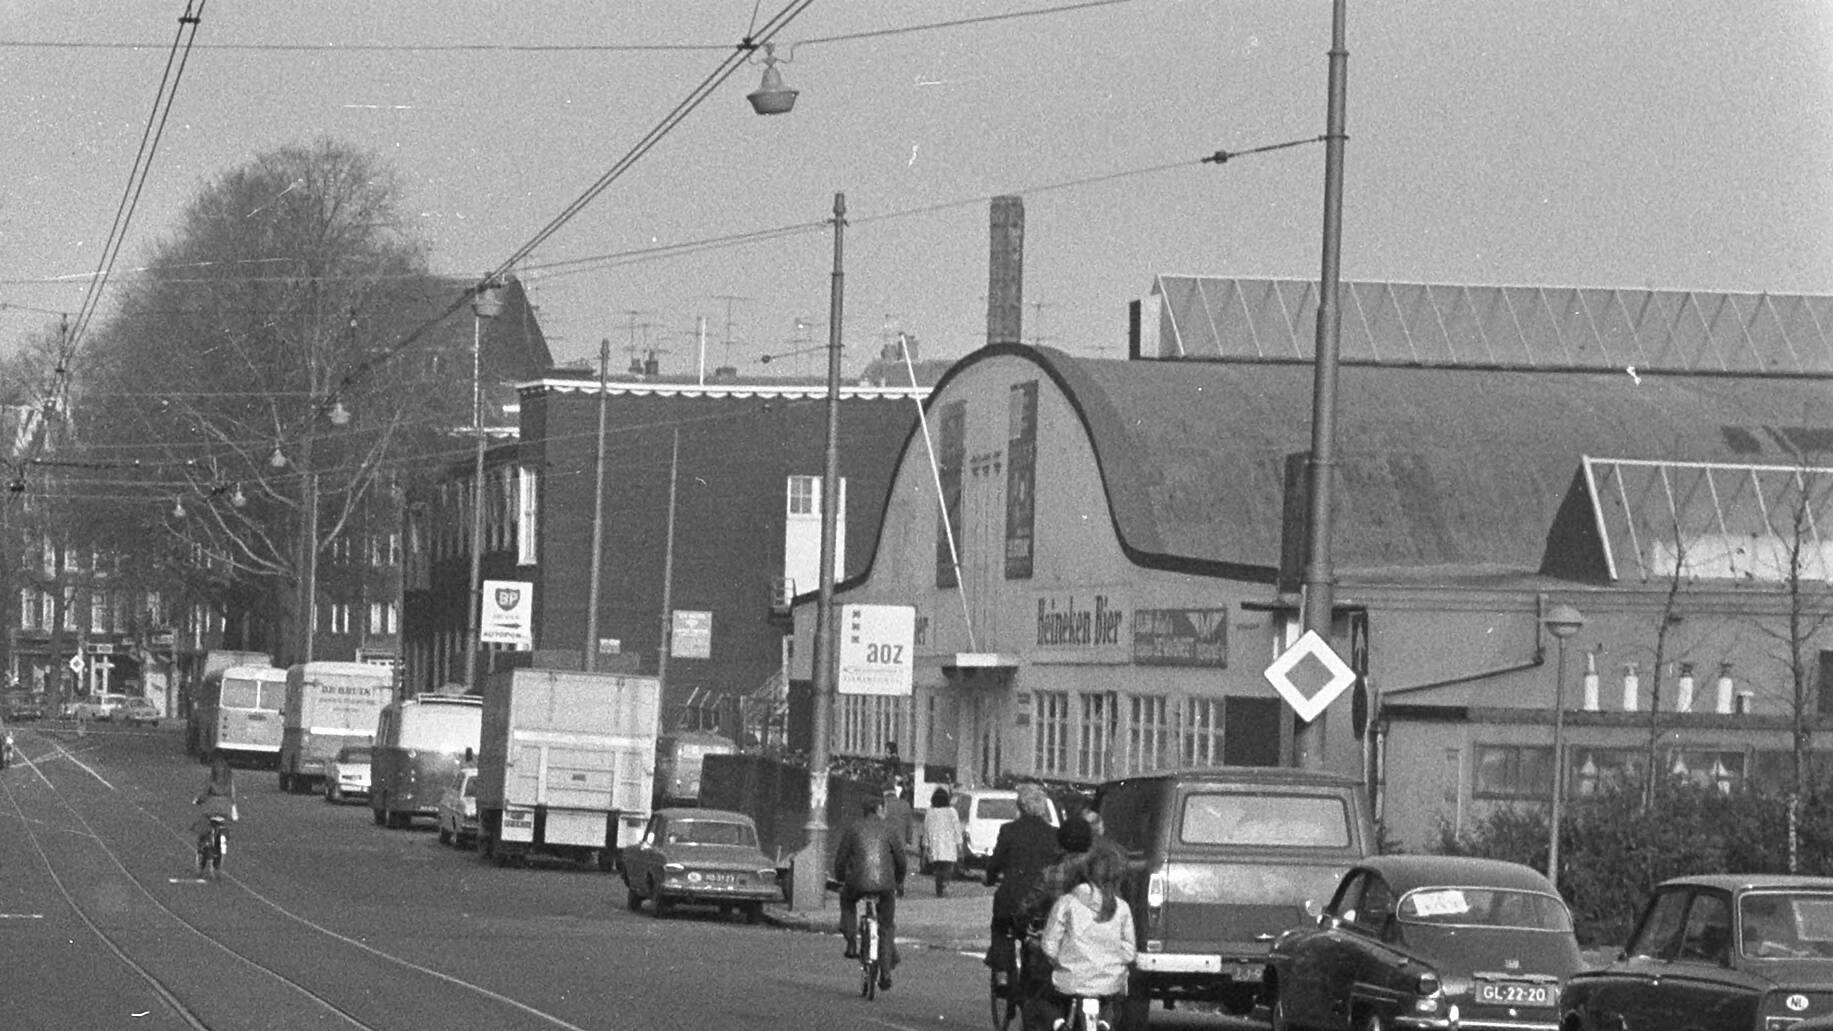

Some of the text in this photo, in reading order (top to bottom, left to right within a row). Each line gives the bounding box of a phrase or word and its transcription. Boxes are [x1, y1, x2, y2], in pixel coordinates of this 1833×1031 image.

[499, 591, 518, 606] BP
[1036, 595, 1091, 646] Heineken
[1093, 594, 1122, 646] Bier
[866, 642, 904, 664] aoz
[1483, 986, 1546, 1002] GL-22-20
